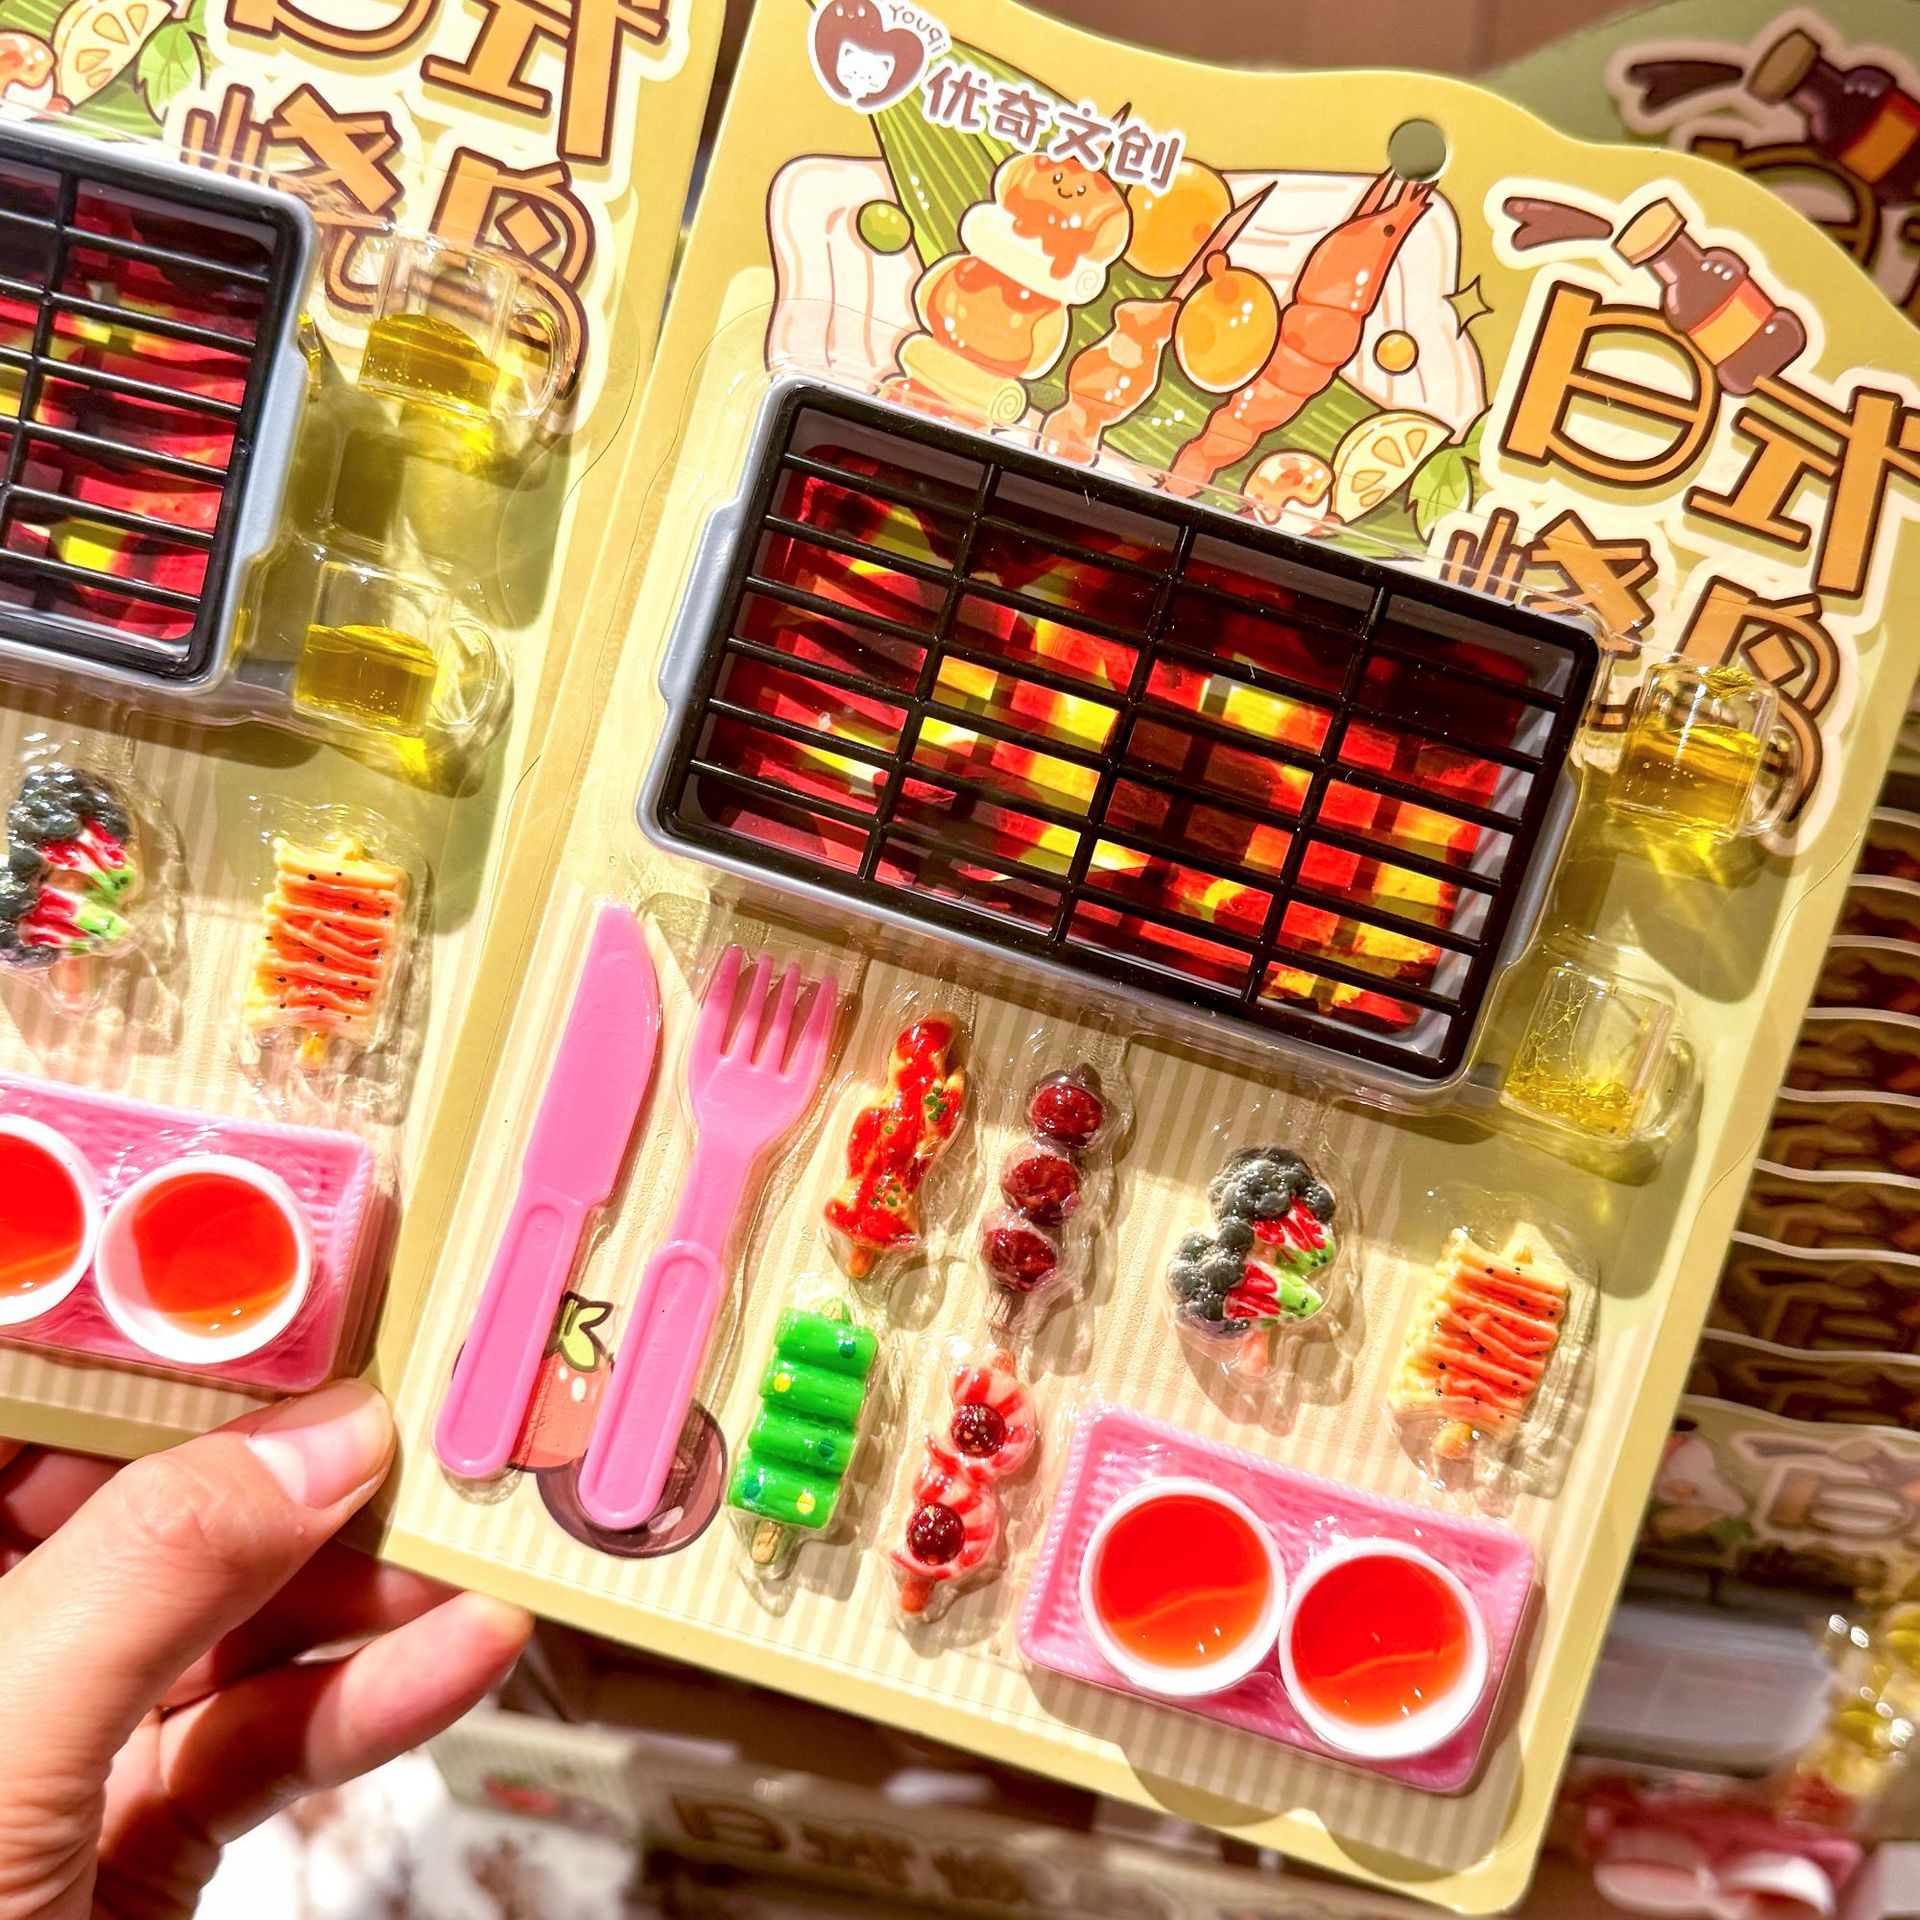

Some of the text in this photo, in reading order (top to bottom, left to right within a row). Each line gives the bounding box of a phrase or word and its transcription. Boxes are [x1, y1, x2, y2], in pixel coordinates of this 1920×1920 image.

[888, 4, 947, 53] Youqi
[926, 65, 1181, 188] 优奇文创
